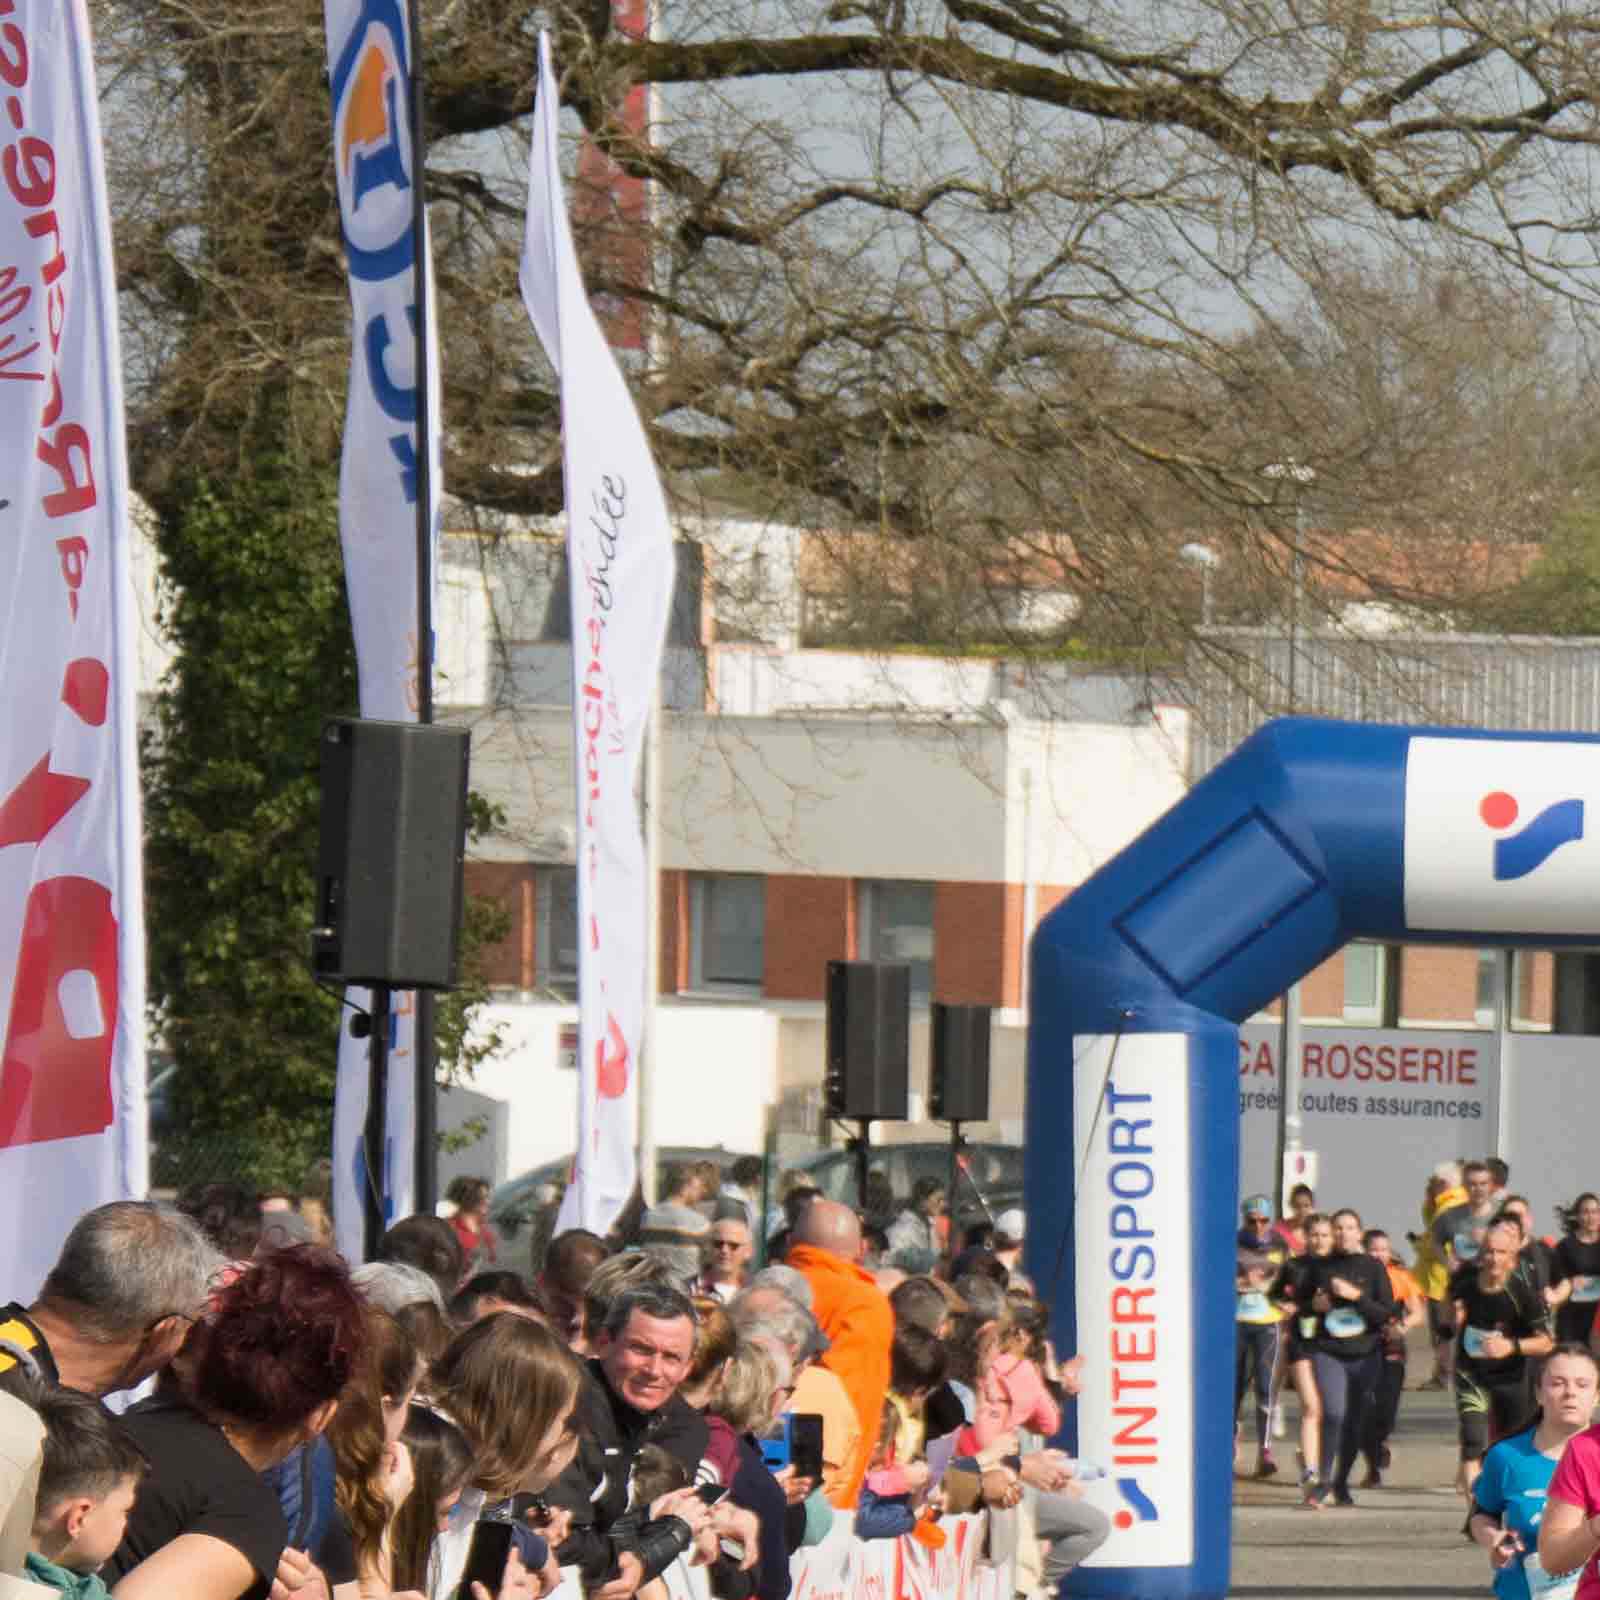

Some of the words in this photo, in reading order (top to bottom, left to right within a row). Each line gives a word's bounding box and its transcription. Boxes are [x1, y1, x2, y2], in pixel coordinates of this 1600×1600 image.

[1240, 1038, 1477, 1085] CAROSSERIE
[1364, 1095, 1482, 1119] assurances
[1107, 1081, 1159, 1467] INTERSPORT
